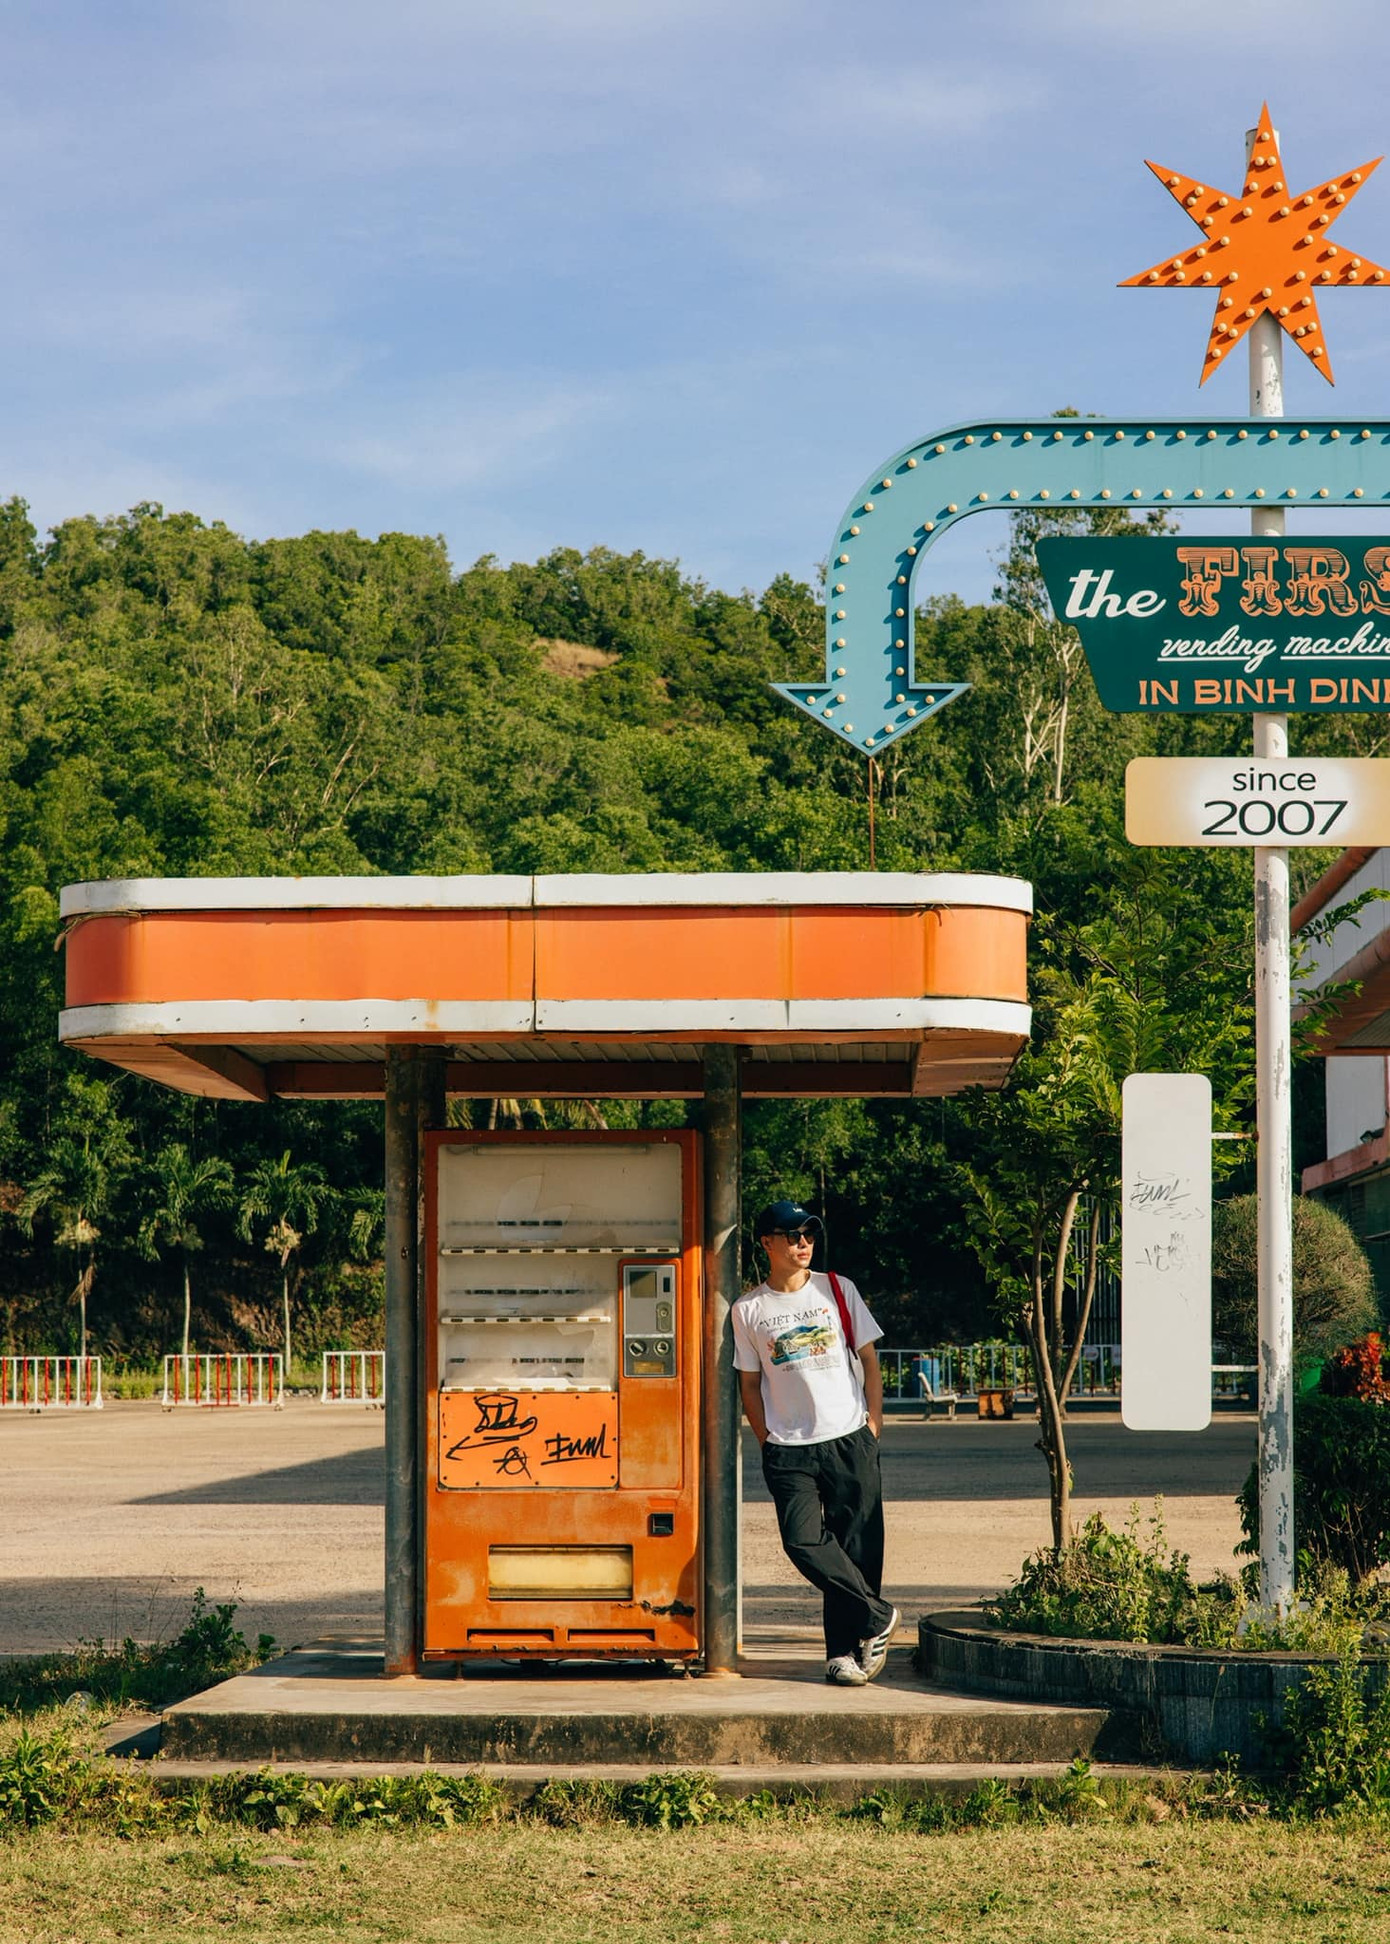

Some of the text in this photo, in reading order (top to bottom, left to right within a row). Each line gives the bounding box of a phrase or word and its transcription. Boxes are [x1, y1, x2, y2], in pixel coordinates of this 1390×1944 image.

[1065, 569, 1166, 618] the
[1160, 624, 1277, 673] vending
[1139, 678, 1390, 705] IN BINH DIN
[1232, 767, 1317, 791] since
[1201, 800, 1349, 836] 2007
